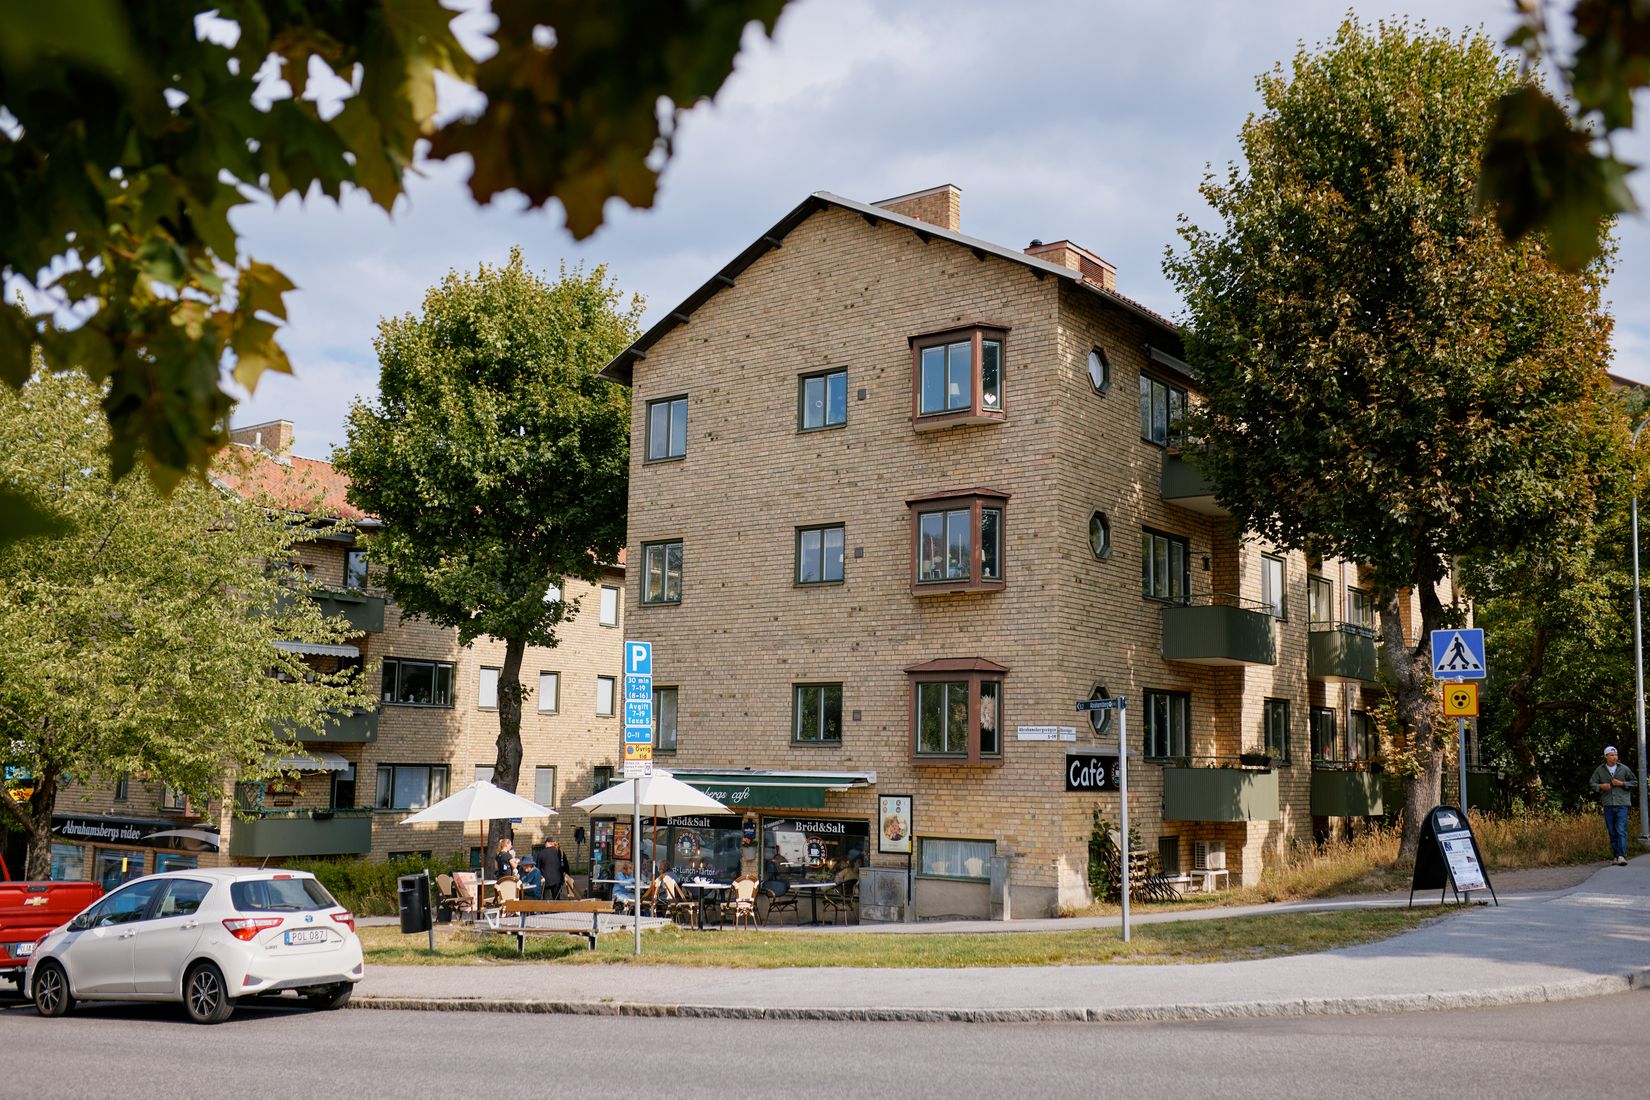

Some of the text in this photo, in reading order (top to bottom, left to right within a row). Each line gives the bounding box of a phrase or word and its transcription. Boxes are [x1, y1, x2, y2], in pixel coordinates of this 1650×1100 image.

[632, 645, 647, 672] P
[628, 691, 649, 699] (8-16)
[628, 703, 649, 711] Avgift
[1069, 758, 1105, 787] Café
[666, 816, 711, 828] Bröd&Salt
[795, 821, 846, 834] Bröd&Salt
[62, 820, 141, 842] Abrahamsbergs video
[292, 932, 307, 941] POL
